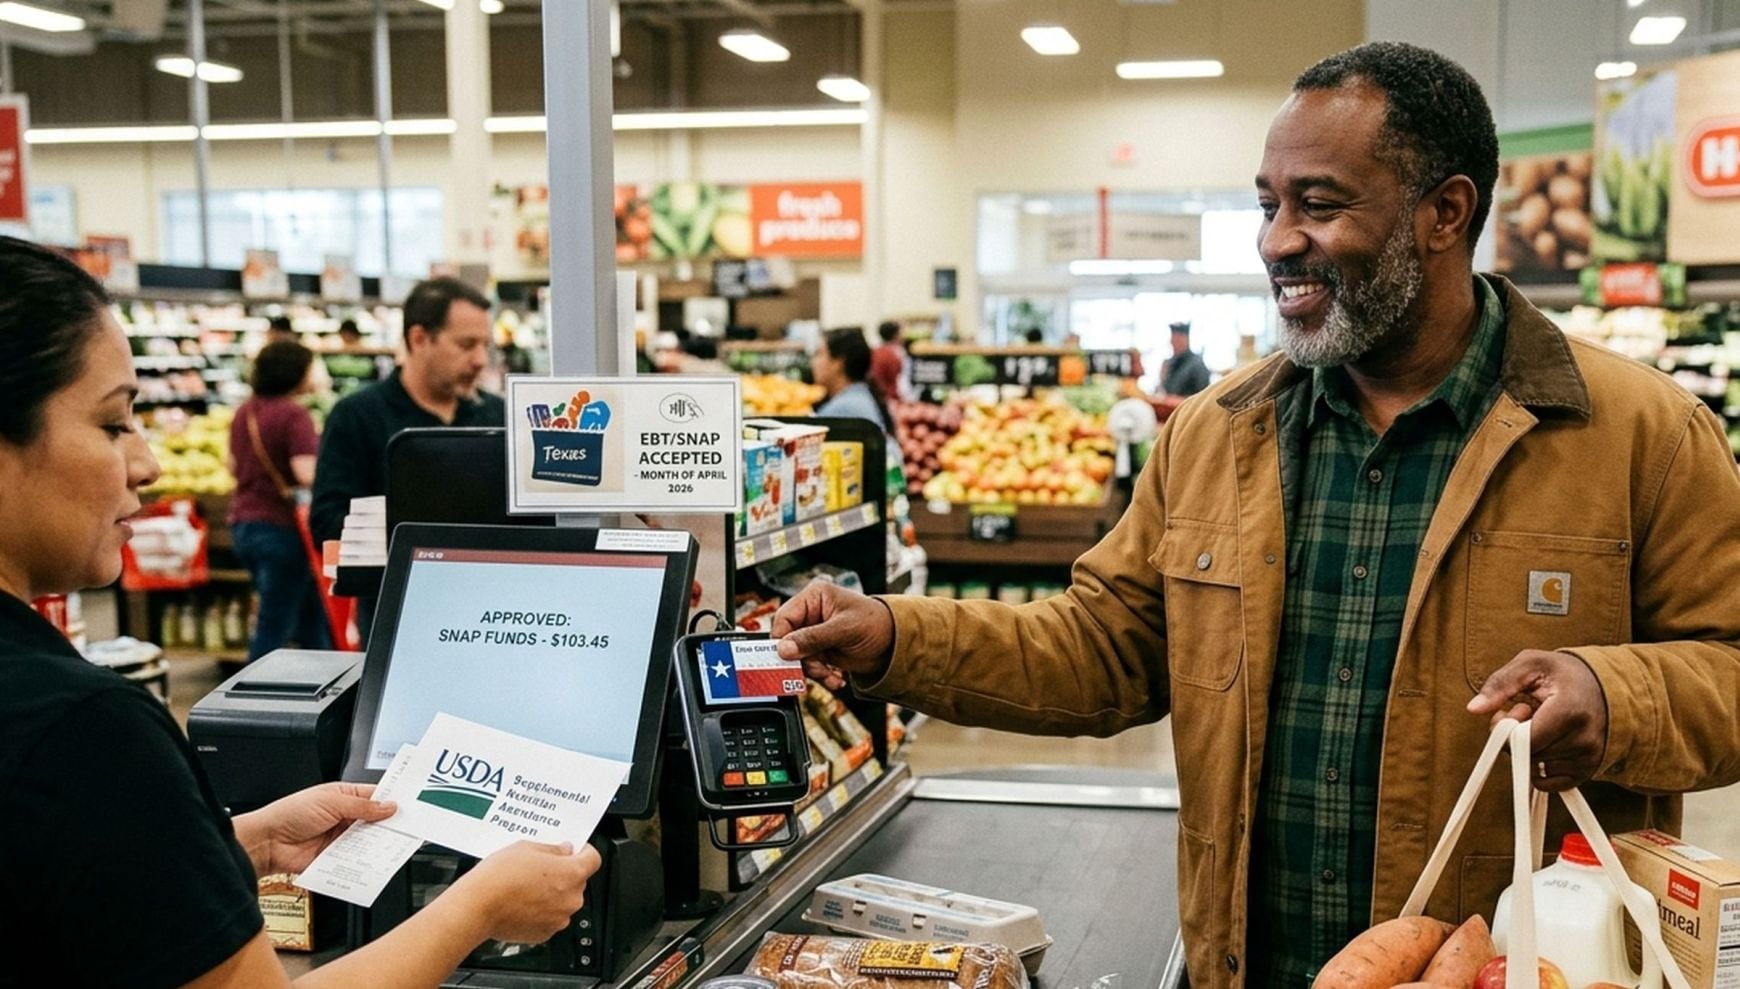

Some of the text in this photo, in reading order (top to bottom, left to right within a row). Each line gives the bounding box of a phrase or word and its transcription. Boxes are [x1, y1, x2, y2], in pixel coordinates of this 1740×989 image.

[1701, 135, 1740, 181] H
[777, 190, 843, 218] fresh
[760, 219, 860, 247] produce
[640, 432, 720, 446] EBT/SNAP
[639, 451, 722, 465] ACCEPTED
[640, 470, 679, 480] MONTH
[680, 470, 694, 480] OF
[697, 470, 727, 480] APRIL
[668, 483, 694, 493] 2026
[480, 611, 571, 627] APPROVED:
[438, 628, 481, 643] SNAP
[484, 630, 537, 646] FUNDS
[550, 633, 609, 649] $103.45
[436, 748, 504, 793] USDA
